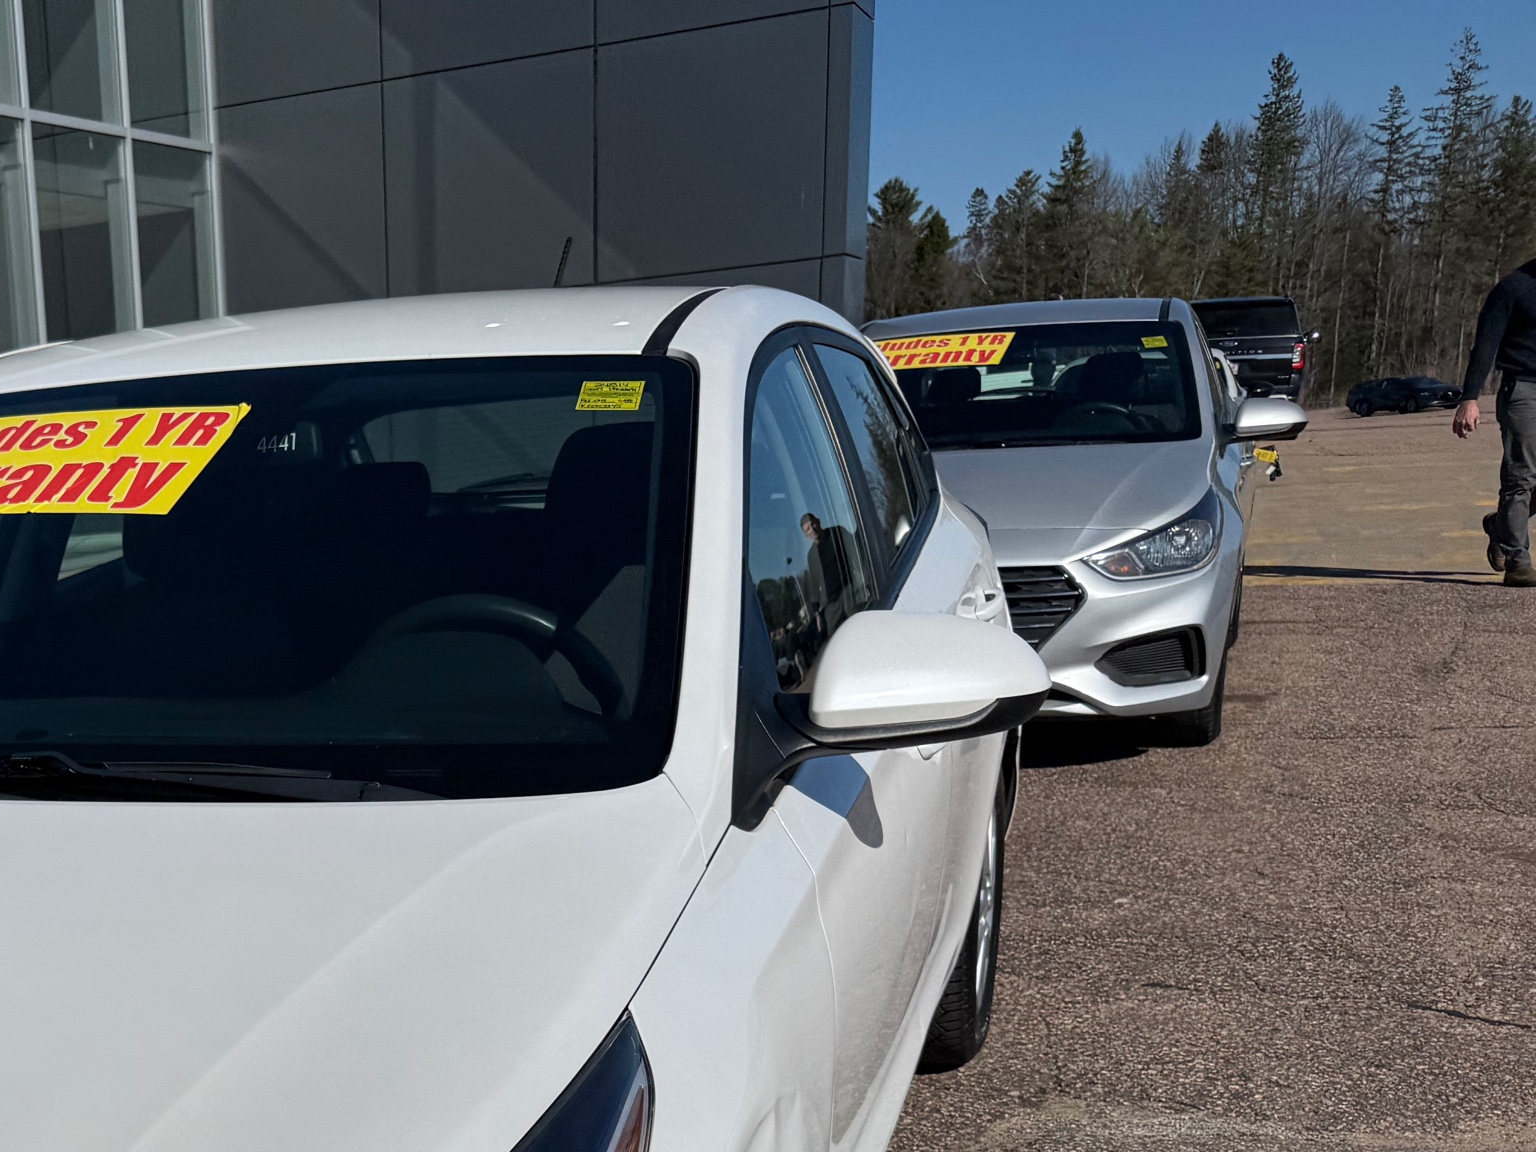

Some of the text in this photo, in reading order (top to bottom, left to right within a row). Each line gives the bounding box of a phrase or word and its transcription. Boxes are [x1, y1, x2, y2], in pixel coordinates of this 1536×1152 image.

[879, 334, 1007, 352] ludes 1 YR
[885, 348, 997, 367] rranty
[105, 412, 146, 448] 1
[144, 410, 232, 447] YR
[257, 432, 296, 453] 4441
